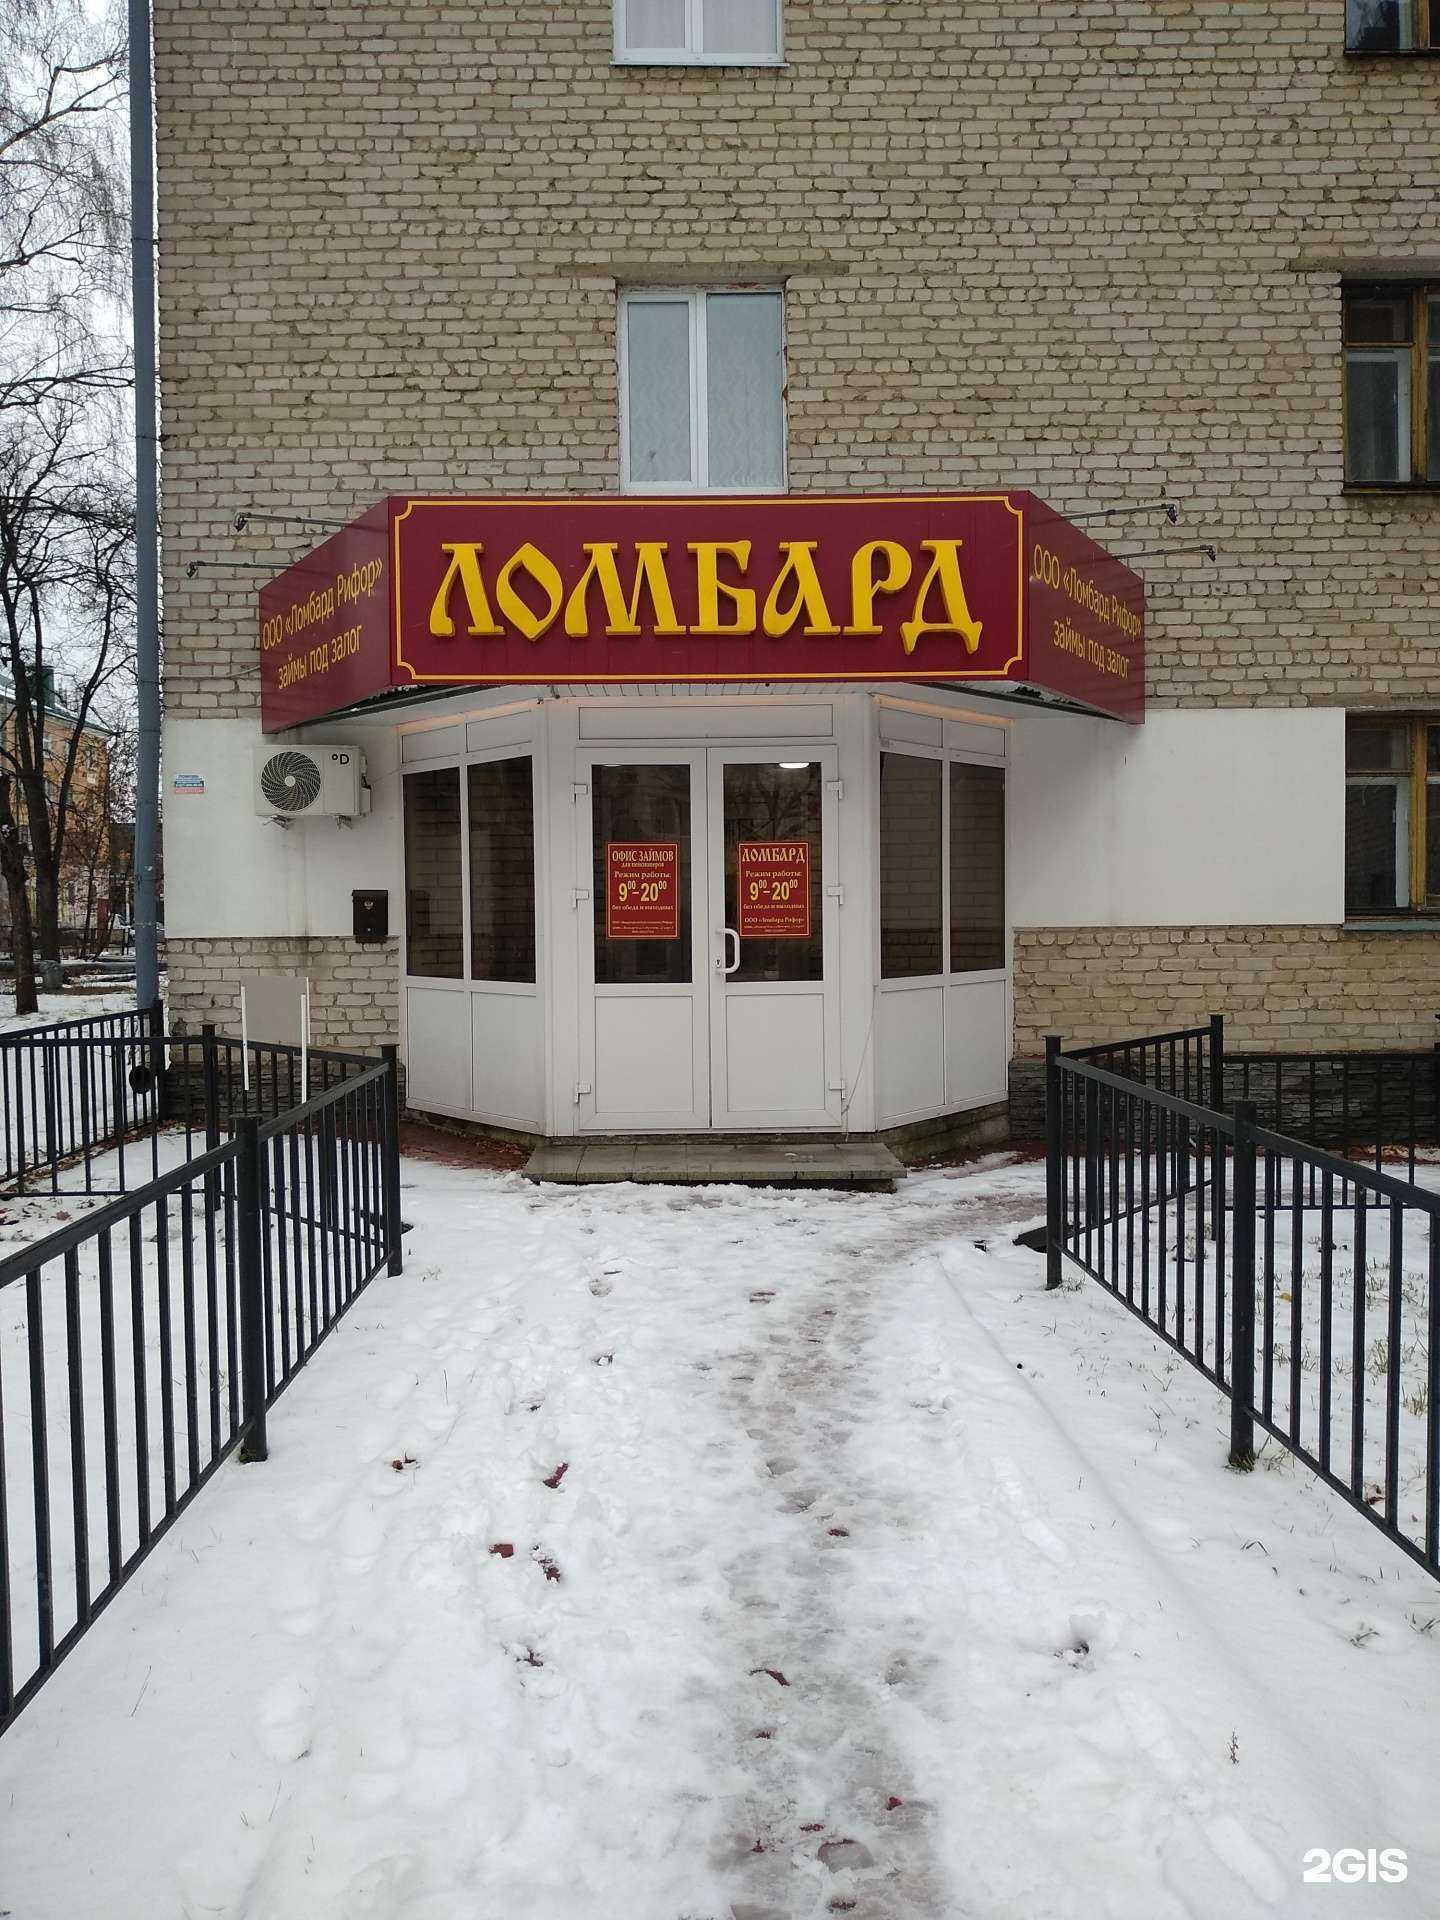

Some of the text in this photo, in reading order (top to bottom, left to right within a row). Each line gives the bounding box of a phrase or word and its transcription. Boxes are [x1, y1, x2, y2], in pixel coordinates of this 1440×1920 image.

[262, 557, 383, 651] ООО «Ломбард Рифор»
[429, 540, 983, 656] ЛОМБАРД
[1033, 543, 1060, 590] ООО
[1063, 567, 1110, 625] «Ломбард
[278, 624, 363, 690] займы под залог
[1053, 617, 1130, 679] займы под залог
[612, 848, 674, 862] ОФИС ЗАЙМОВ
[742, 847, 806, 864] ЛОМБАРД
[745, 870, 771, 878] Режим
